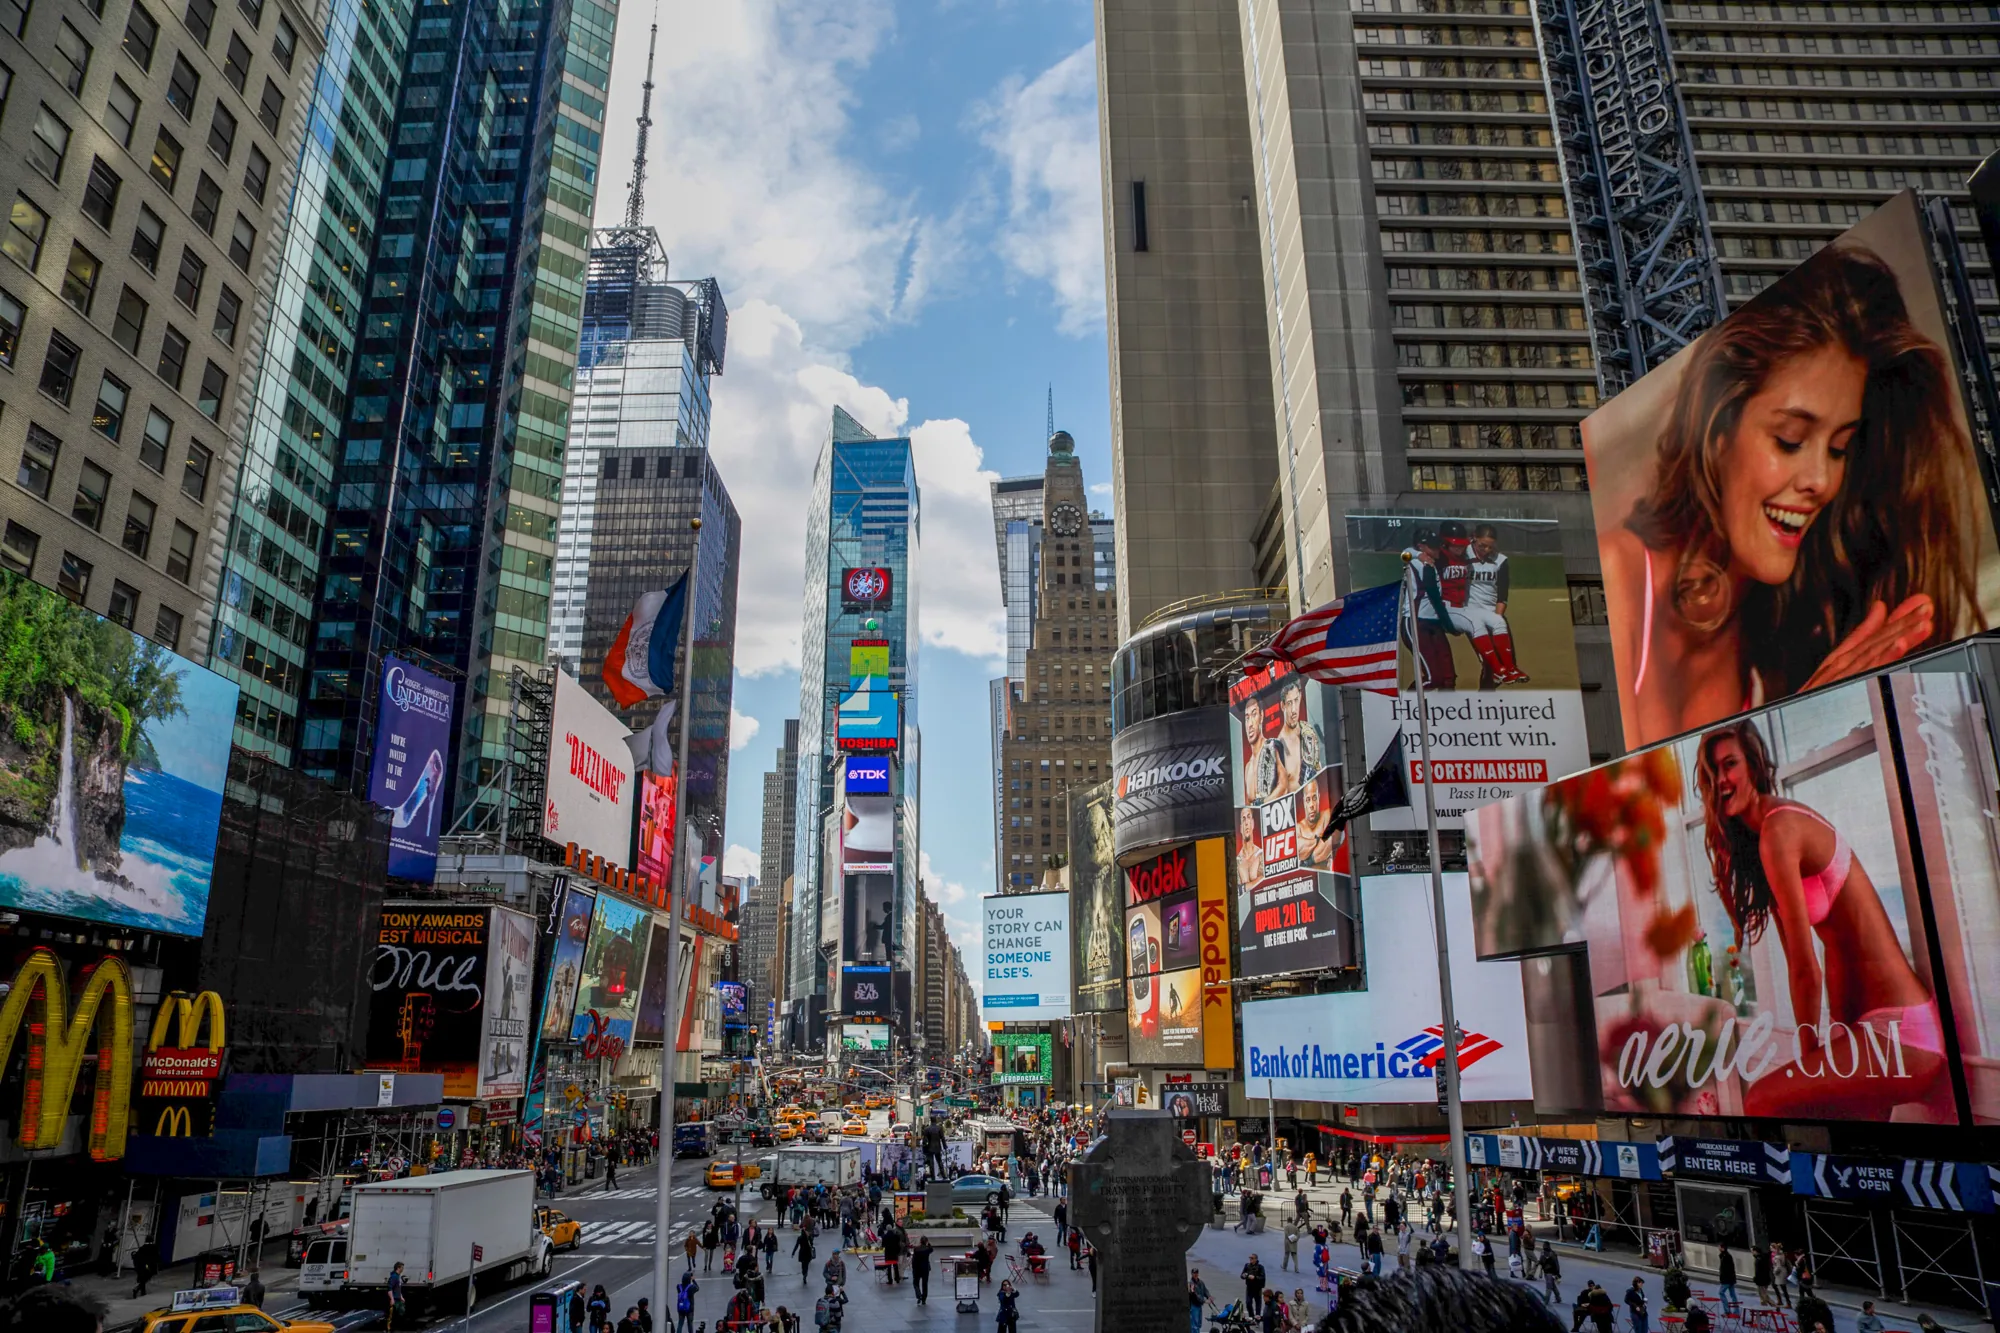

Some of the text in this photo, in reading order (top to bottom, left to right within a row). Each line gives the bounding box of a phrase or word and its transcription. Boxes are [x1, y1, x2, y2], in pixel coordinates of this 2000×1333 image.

[1388, 520, 1401, 528] 215
[1443, 565, 1466, 579] WEST
[386, 666, 450, 718] CINDERELLA
[1478, 698, 1556, 726] injured
[390, 734, 406, 748] YOU'RE
[840, 738, 896, 748] TOSHIBA
[1507, 725, 1556, 748] win.
[389, 748, 406, 763] INVITED
[388, 763, 402, 777] TO THE
[857, 770, 886, 779] TDK
[1415, 762, 1544, 780] SORTSMANSHIP
[386, 778, 396, 791] BALL
[1138, 777, 1224, 799] driving emotion
[1448, 787, 1478, 800] Pass
[1479, 788, 1489, 800] It
[1263, 796, 1294, 836] FOX
[1265, 831, 1295, 861] UFC
[1264, 857, 1297, 876] SATURDAY
[1130, 848, 1188, 904] Kodak
[382, 914, 484, 928] TONY AWARDS
[988, 908, 1023, 920] YOUR
[1255, 907, 1281, 933] APRIL
[1284, 902, 1297, 926] 20
[988, 920, 1062, 934] STORY CAN
[1294, 926, 1308, 942] FOX
[414, 930, 482, 944] MUSICAL
[988, 937, 1041, 949] CHANGE
[988, 951, 1051, 964] SOMEONE
[1201, 899, 1228, 1008] Kodak
[988, 967, 1032, 979] ELSE'S.
[857, 982, 874, 992] EVIL
[854, 990, 879, 1000] DEAD
[582, 1008, 625, 1075] Disney
[145, 1056, 217, 1067] McDonald's
[1250, 1042, 1433, 1078] Bank of America
[1196, 1092, 1218, 1105] Jekyll
[1199, 1102, 1222, 1114] Hyde
[1557, 1146, 1579, 1156] WE'RE
[1696, 1143, 1722, 1151] AMERICAN
[1558, 1156, 1577, 1164] OPEN
[1685, 1157, 1756, 1175] ENTER HERE
[1856, 1167, 1894, 1179] WE'RE
[1858, 1179, 1891, 1192] OPEN
